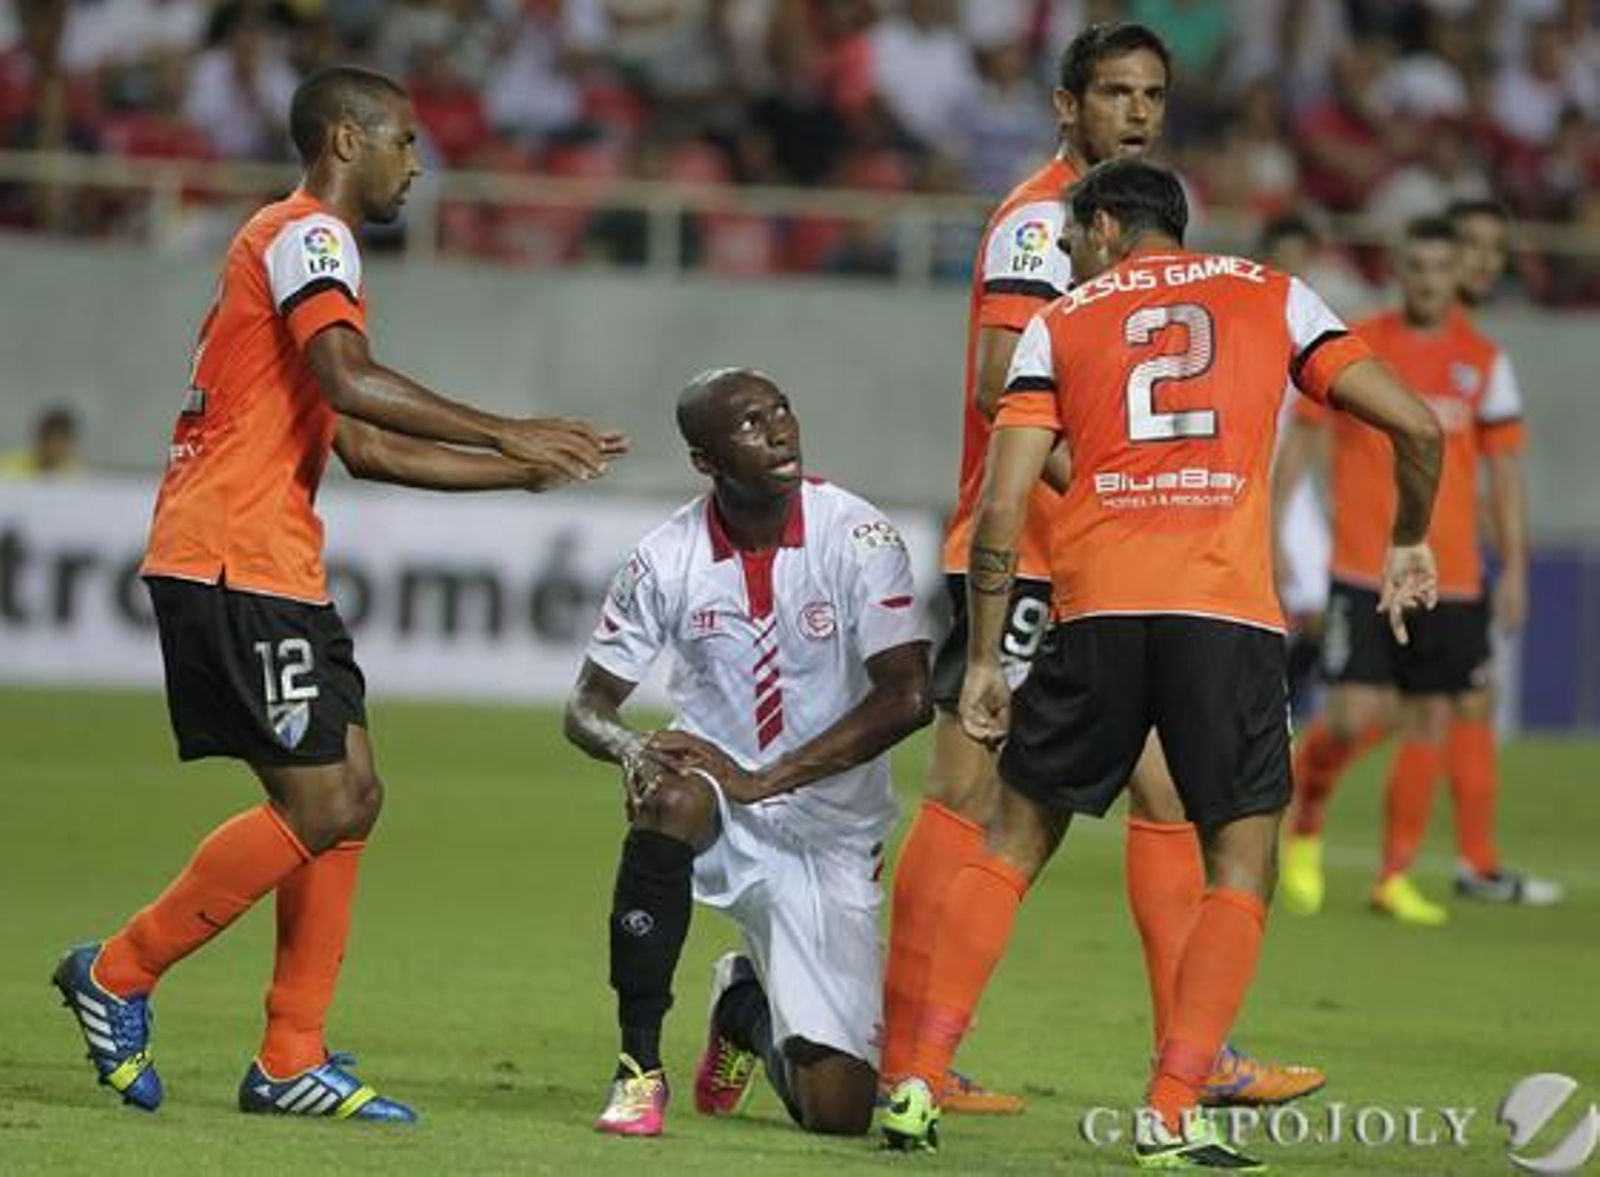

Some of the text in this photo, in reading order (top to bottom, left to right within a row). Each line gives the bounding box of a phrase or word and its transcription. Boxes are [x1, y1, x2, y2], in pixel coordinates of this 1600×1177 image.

[309, 256, 340, 273] LFP
[1012, 253, 1043, 272] LFP
[1063, 256, 1266, 314] JESUS GAMEZ
[1124, 303, 1218, 442] 2
[1095, 469, 1246, 495] BlueBay
[1004, 597, 1050, 656] 9
[254, 638, 319, 702] 12
